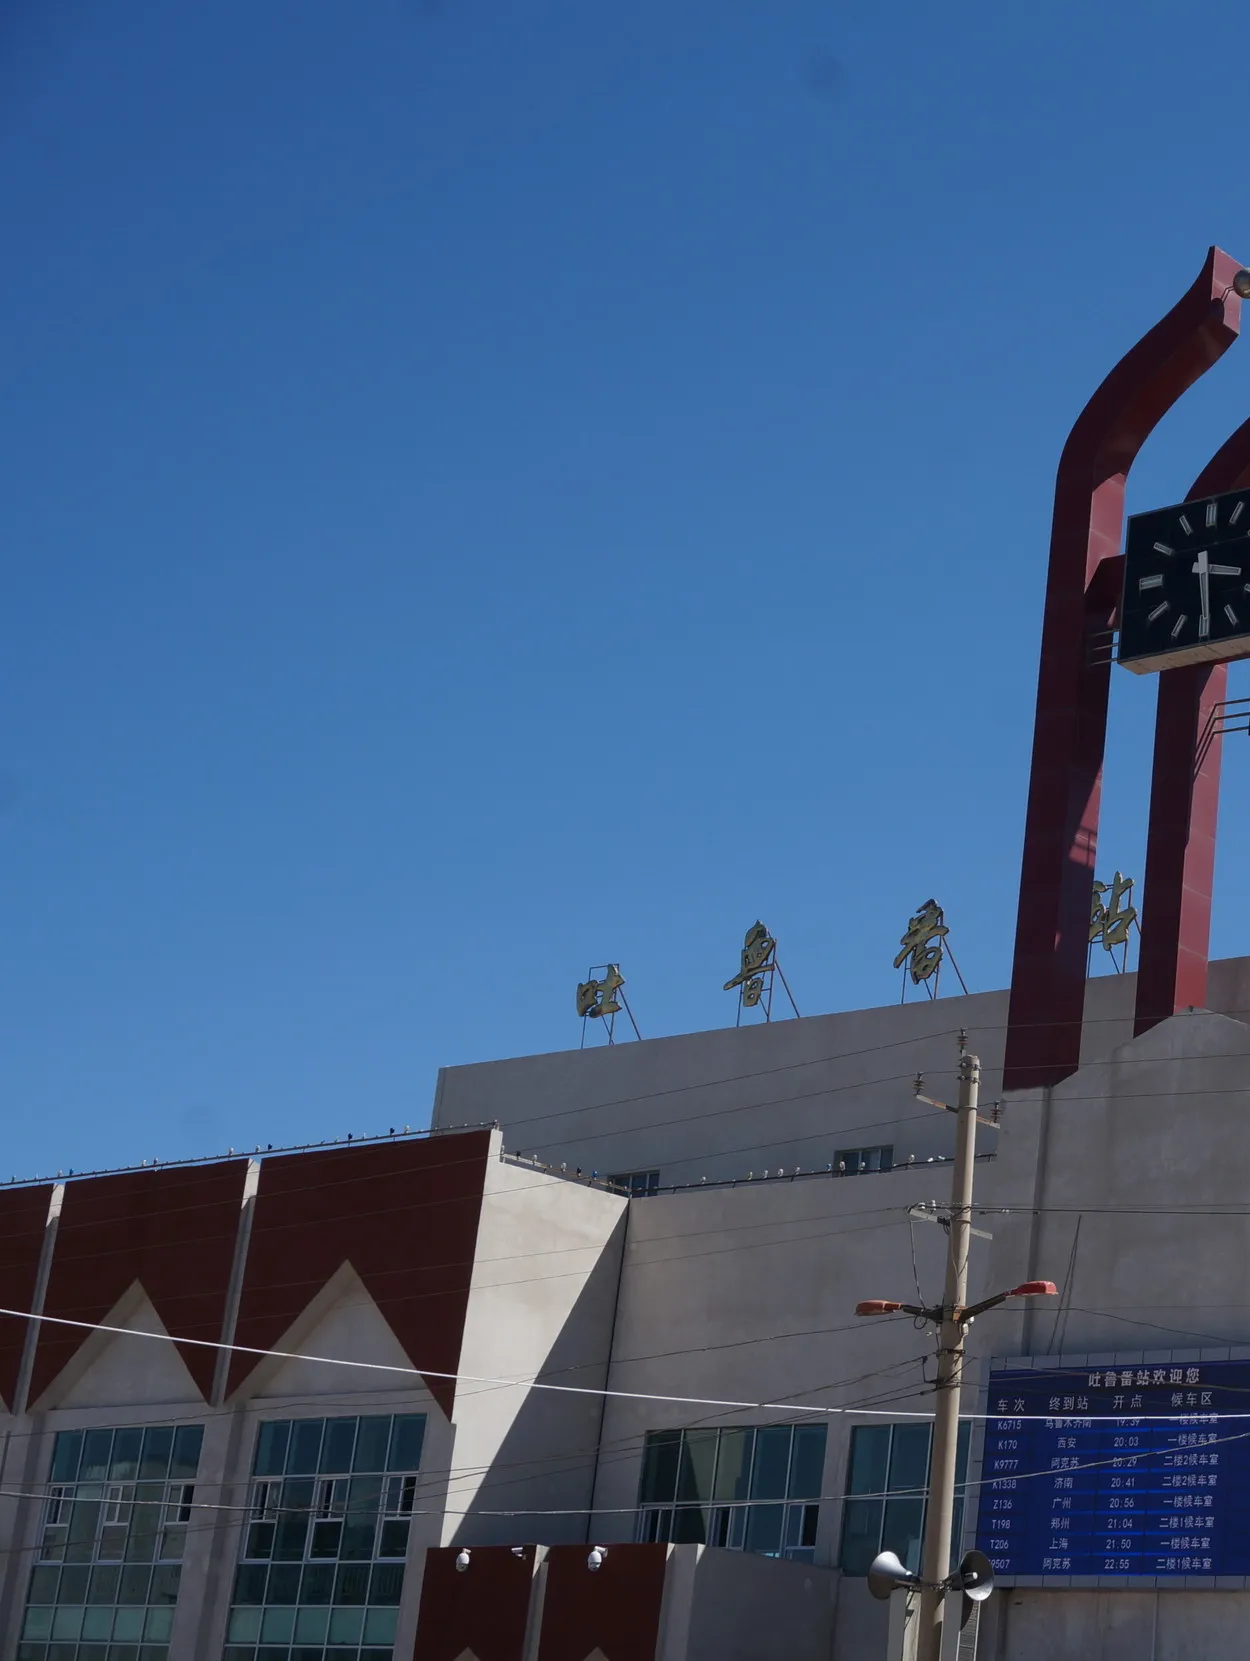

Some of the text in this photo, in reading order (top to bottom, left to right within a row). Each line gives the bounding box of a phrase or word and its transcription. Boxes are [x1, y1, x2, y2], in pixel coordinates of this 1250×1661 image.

[1088, 1367, 1200, 1388] 吐鲁番站欢迎您
[1049, 1395, 1089, 1411] 终到站
[1171, 1391, 1213, 1407] 候车区
[997, 1419, 1022, 1430] K6715
[998, 1439, 1018, 1450] K170
[1057, 1437, 1077, 1449] 西安
[1113, 1436, 1139, 1448] 20:03
[1167, 1433, 1218, 1446] 一楼候车室
[994, 1459, 1019, 1470] K9777
[1050, 1457, 1080, 1470] 阿克苏
[1163, 1453, 1219, 1467] 二楼2候车室
[1053, 1477, 1074, 1490] 济南
[1110, 1477, 1136, 1488] 20:41
[1162, 1474, 1218, 1487] 二楼2候车室
[992, 1499, 1013, 1510] Z136
[1052, 1497, 1072, 1509] 广州
[1109, 1497, 1135, 1509] 20:56
[1163, 1495, 1214, 1508] 一楼候车室
[991, 1519, 1011, 1530] T198
[1050, 1517, 1070, 1530] 郑州
[1107, 1518, 1133, 1529] 21:04
[990, 1539, 1010, 1550] T206
[1049, 1537, 1069, 1550] 上海
[1160, 1536, 1211, 1550] 一楼候车室
[988, 1559, 1011, 1569] 9507
[1042, 1557, 1072, 1570] 阿克苏
[1104, 1558, 1130, 1570] 22:55
